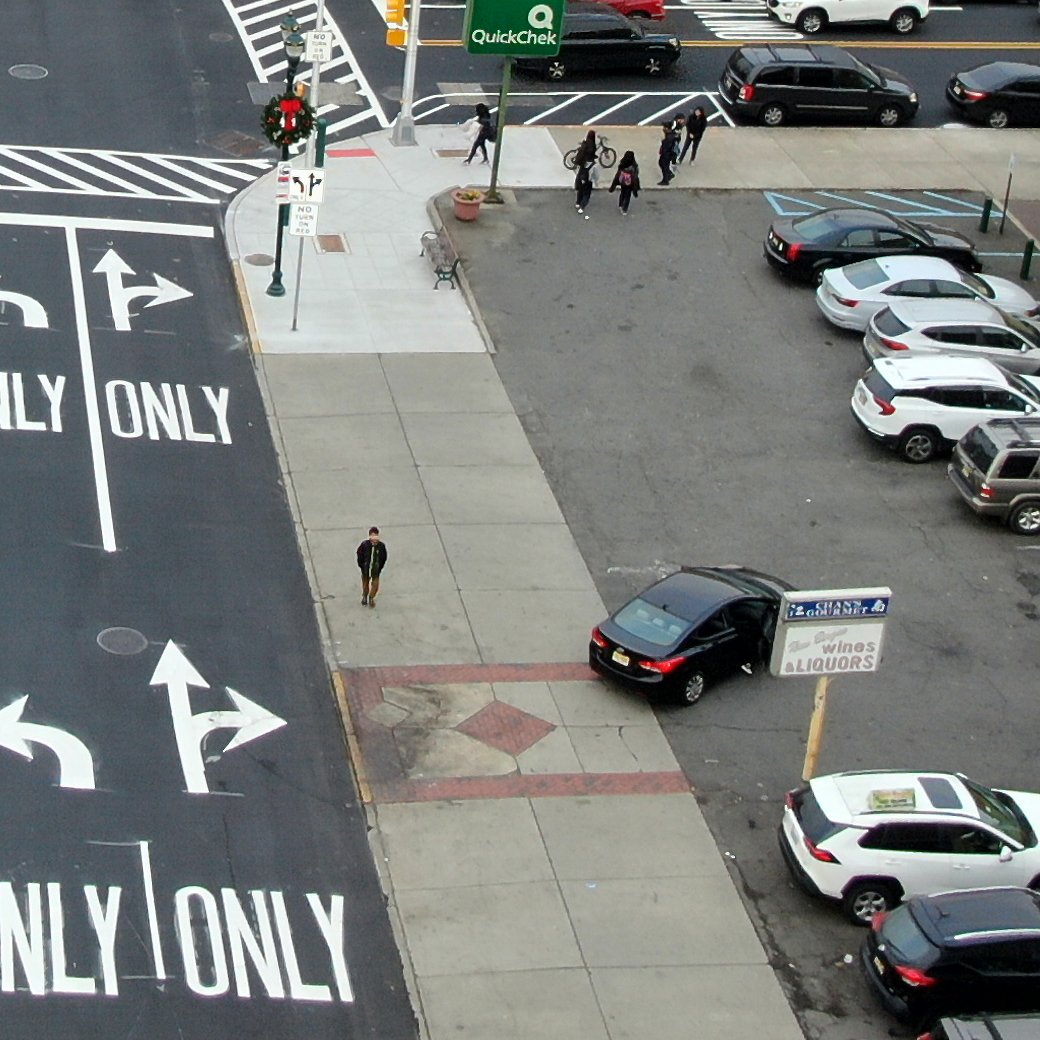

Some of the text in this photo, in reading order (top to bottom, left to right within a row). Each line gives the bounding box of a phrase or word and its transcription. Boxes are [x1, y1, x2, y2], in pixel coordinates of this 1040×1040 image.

[471, 28, 558, 45] QuickChek
[105, 379, 233, 445] ONLY
[174, 885, 354, 1002] ONLY
